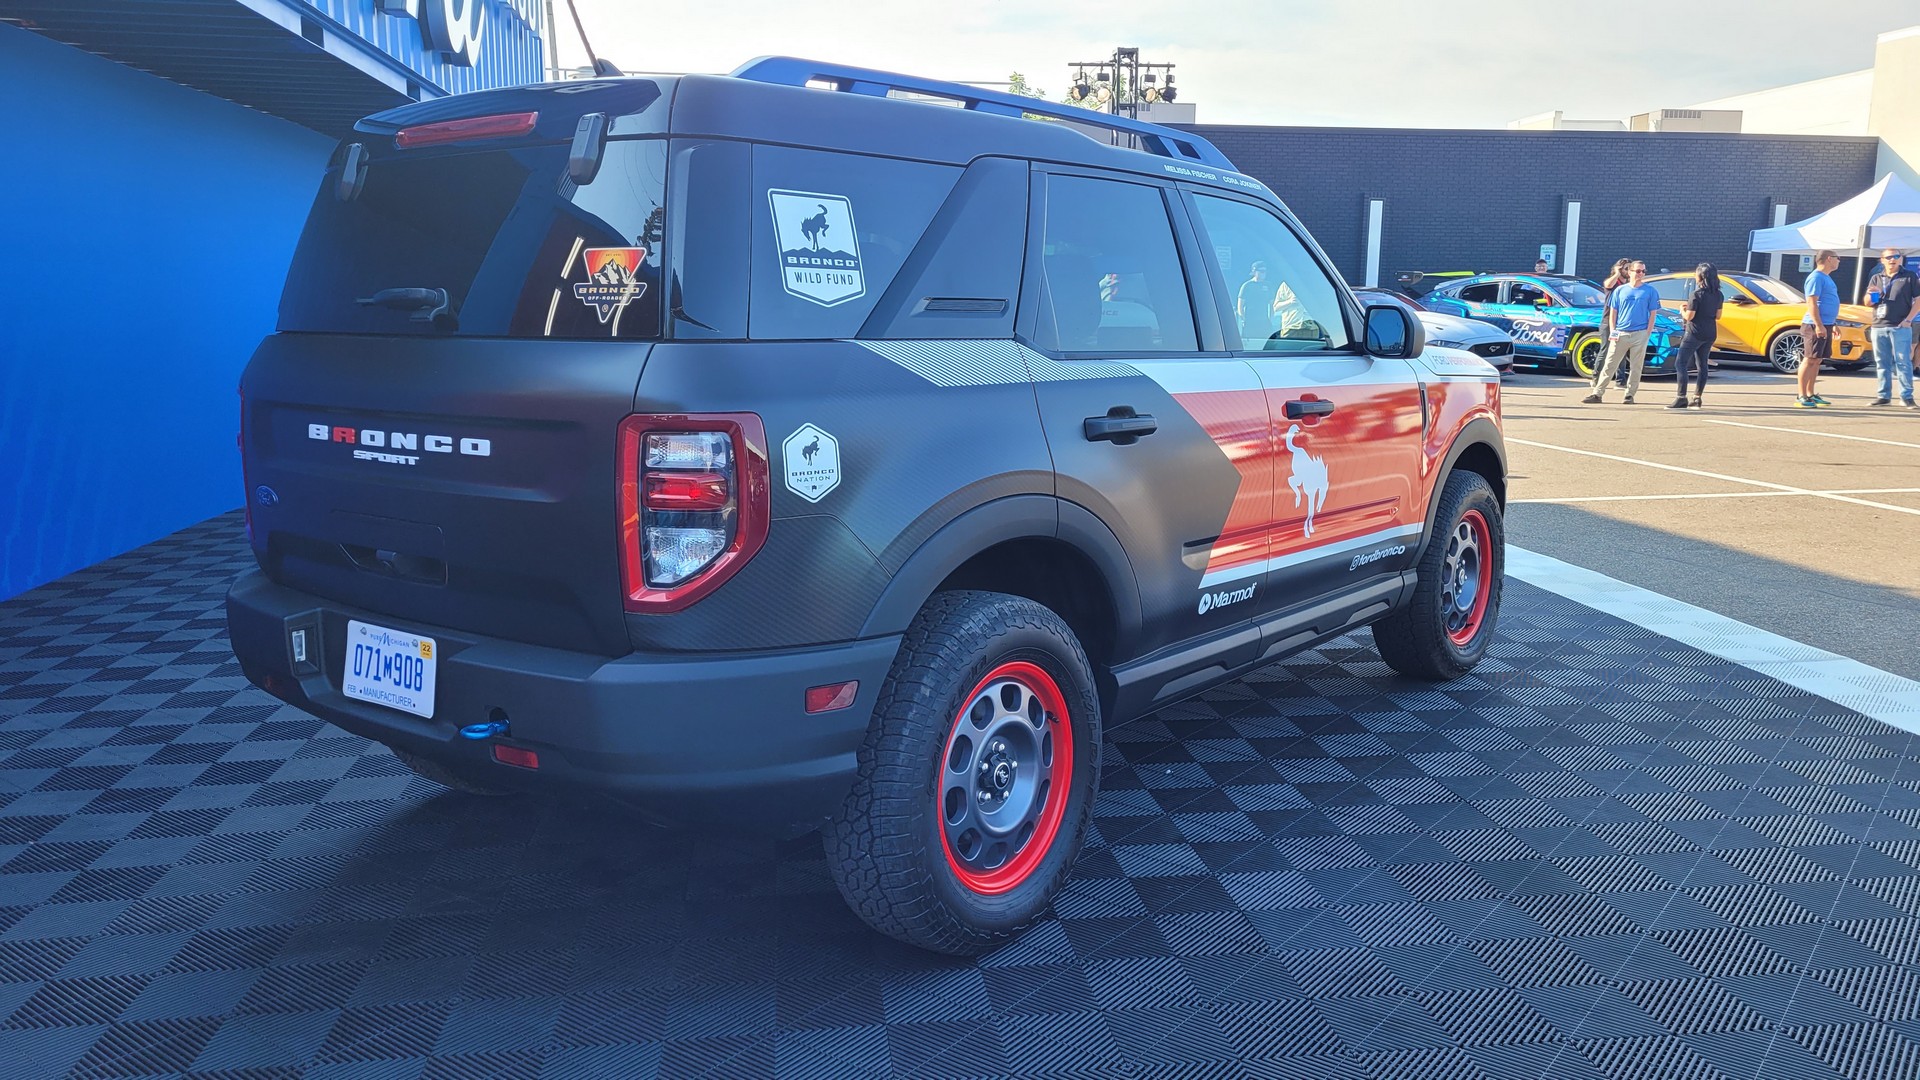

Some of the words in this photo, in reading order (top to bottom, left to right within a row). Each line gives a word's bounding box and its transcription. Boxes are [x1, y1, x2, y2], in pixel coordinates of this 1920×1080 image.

[787, 256, 855, 267] BRONCO
[794, 271, 822, 284] WILD
[826, 273, 854, 286] FUND
[1508, 319, 1556, 344] Ford
[308, 423, 491, 457] BRONCO
[353, 449, 420, 466] SPORT
[791, 468, 835, 477] BRONCO
[796, 475, 831, 483] NATION
[1209, 582, 1257, 610] Marmot
[422, 643, 431, 653] 22
[353, 643, 424, 692] 071M908
[347, 684, 357, 694] FEB
